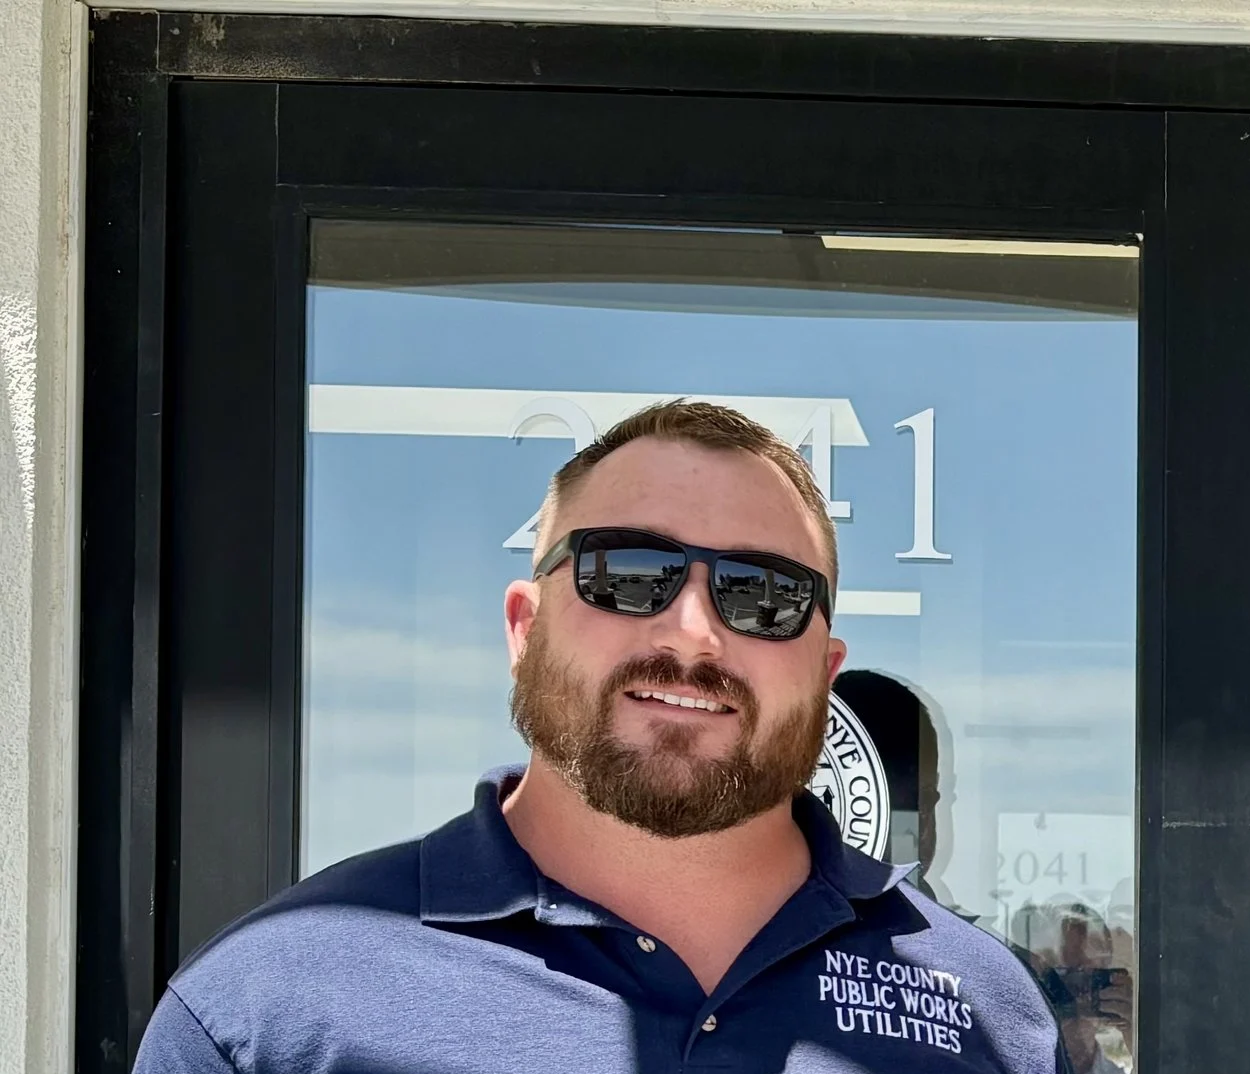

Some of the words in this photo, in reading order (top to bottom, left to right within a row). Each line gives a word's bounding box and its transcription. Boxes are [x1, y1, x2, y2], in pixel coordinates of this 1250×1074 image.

[826, 715, 862, 770] NYE
[825, 950, 872, 978] NYE
[876, 961, 960, 997] COUNTY
[818, 975, 896, 1009] PUBLIC
[900, 987, 972, 1029] WORKS
[836, 1007, 962, 1053] UTILITIES
